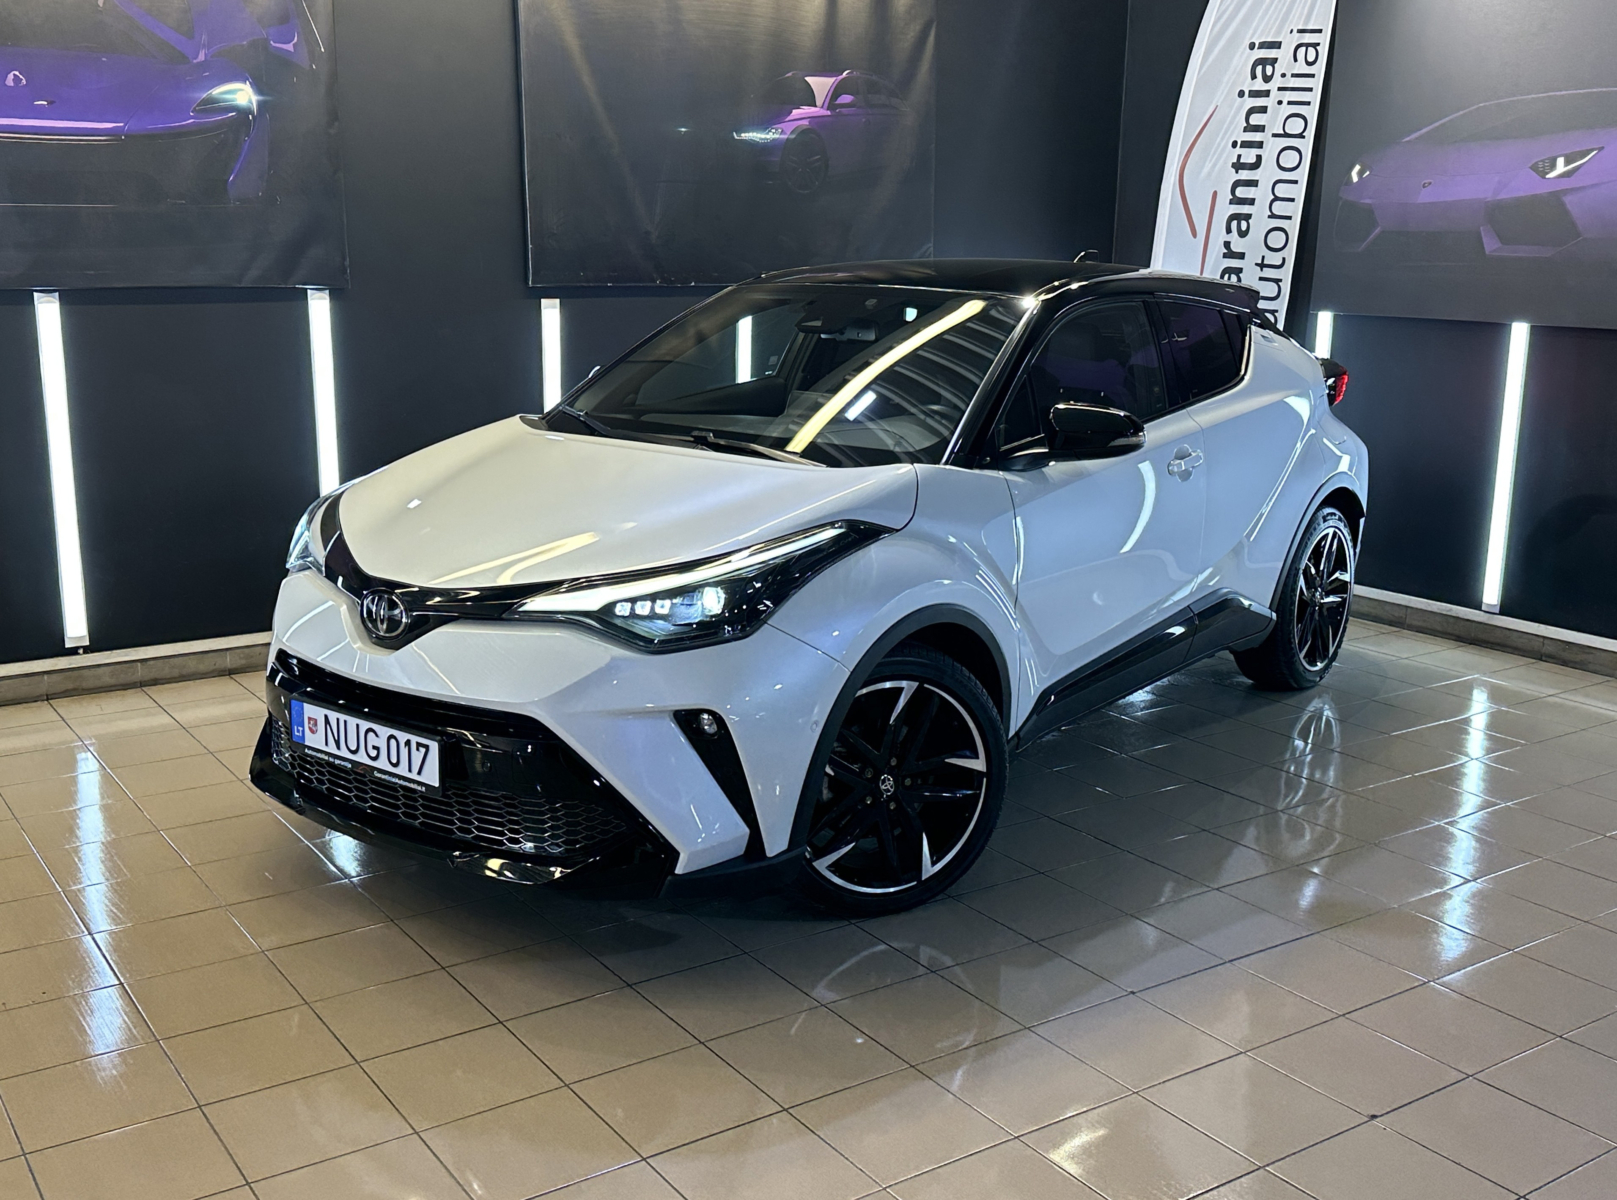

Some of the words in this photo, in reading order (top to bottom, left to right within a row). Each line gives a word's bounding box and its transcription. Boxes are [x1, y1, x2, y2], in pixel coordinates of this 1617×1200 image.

[1220, 40, 1282, 283] arantiniai
[294, 725, 303, 737] LT
[324, 713, 430, 776] NUG017
